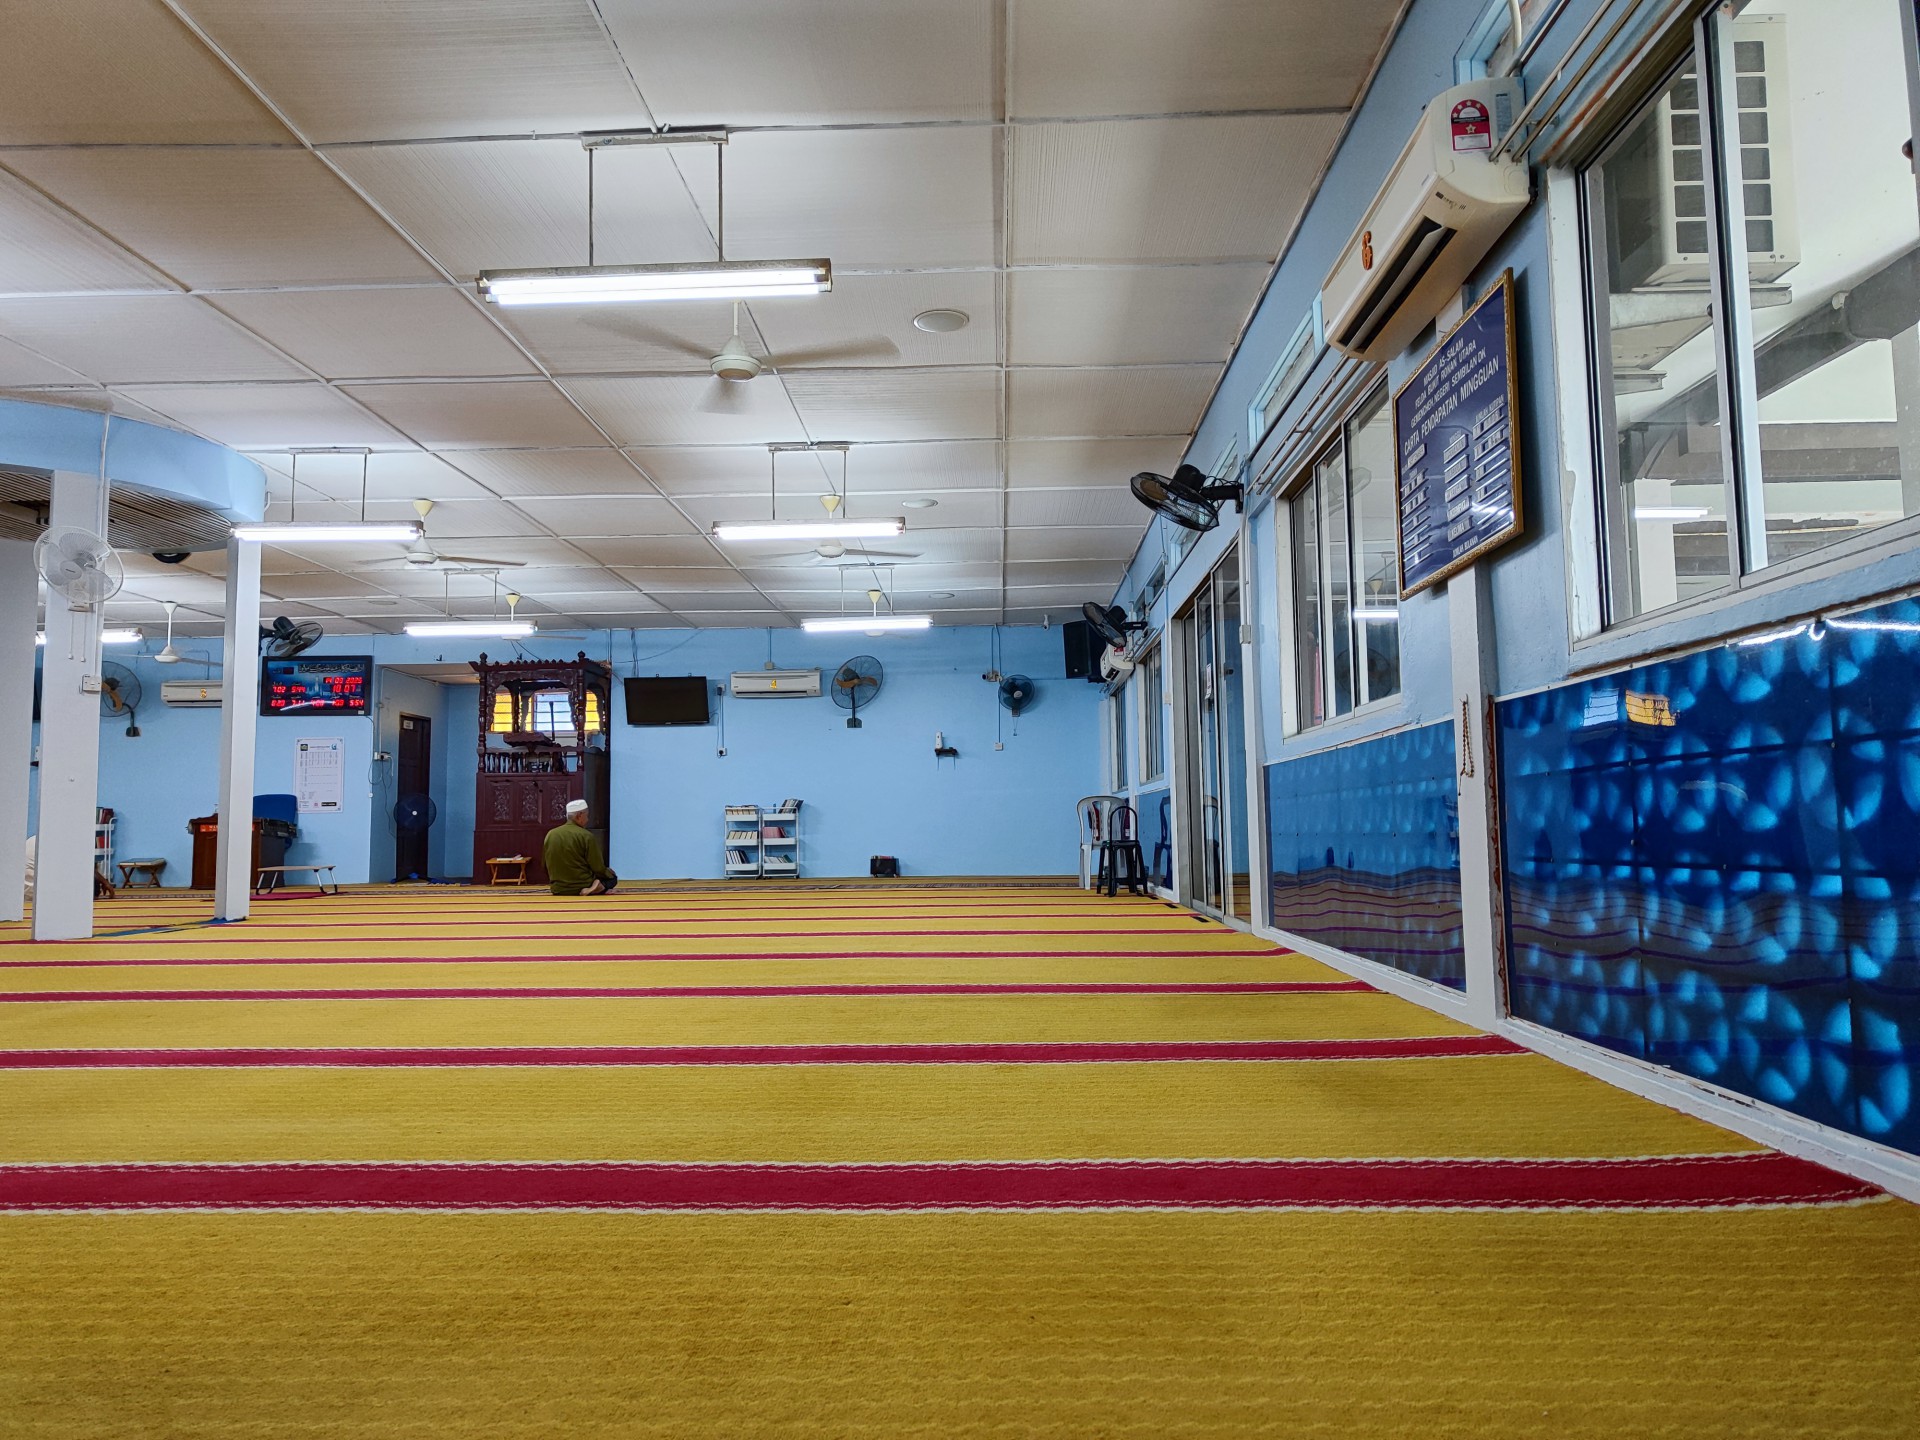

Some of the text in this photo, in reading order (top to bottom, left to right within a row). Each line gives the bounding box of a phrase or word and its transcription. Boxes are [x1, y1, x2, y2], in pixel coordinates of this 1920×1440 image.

[1362, 231, 1374, 271] 6
[1415, 390, 1426, 409] FELDA
[1428, 374, 1439, 396] BUKIT
[1459, 340, 1476, 362] UTARA
[1424, 338, 1463, 387] MASJID AS-SALAM
[1452, 357, 1477, 387] SEMBILAN
[1404, 429, 1419, 456] CARTA
[1421, 394, 1457, 438] PENDAPATAN
[1461, 355, 1498, 402] MINGGUAN
[770, 679, 777, 689] 4
